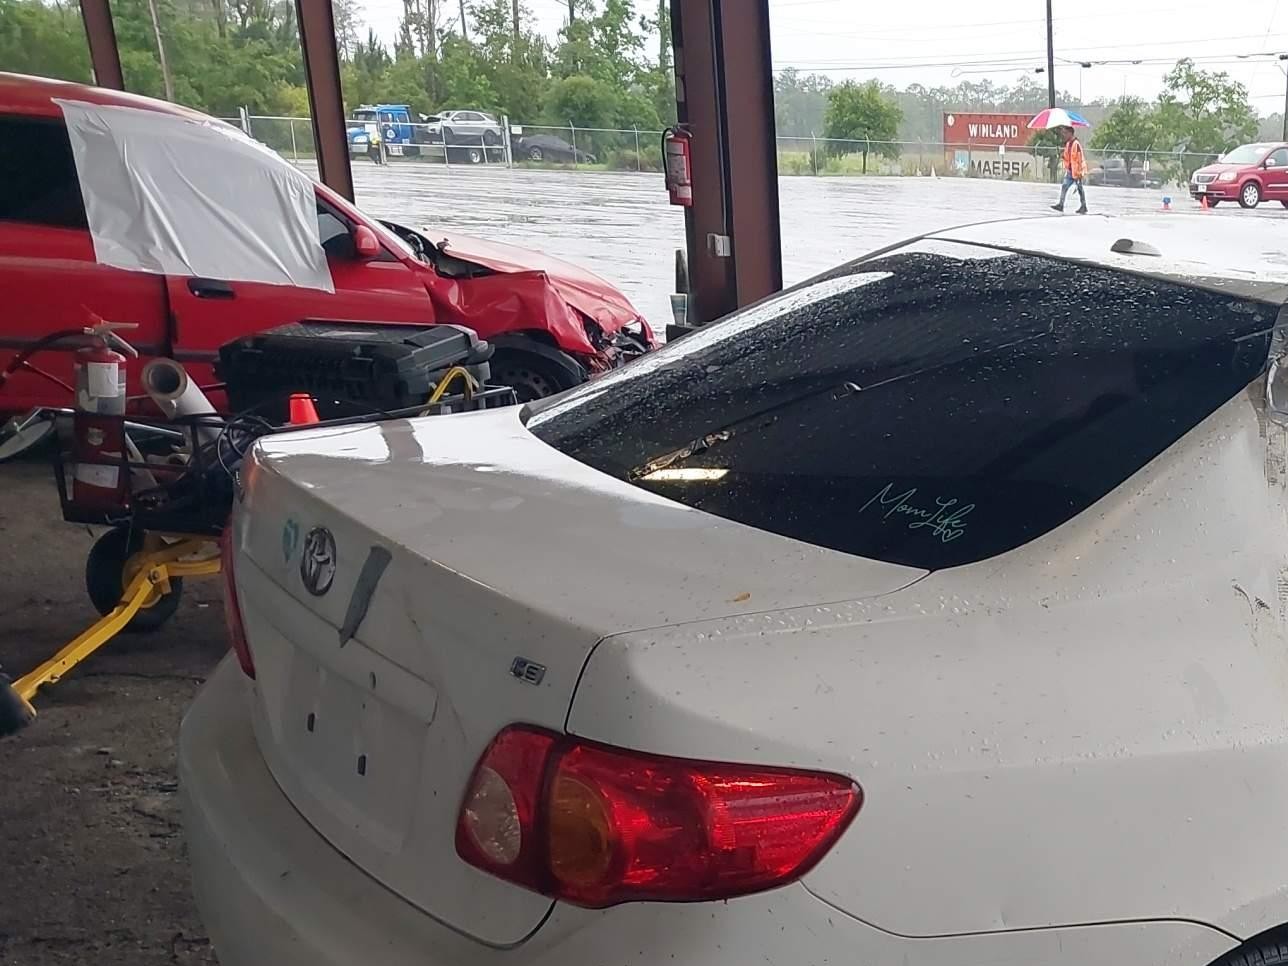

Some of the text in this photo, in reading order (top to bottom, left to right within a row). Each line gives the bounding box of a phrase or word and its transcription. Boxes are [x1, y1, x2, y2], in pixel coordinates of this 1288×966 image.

[968, 124, 1018, 138] WINLAND
[971, 160, 1029, 176] MAERSK
[858, 482, 976, 536] Mom Life
